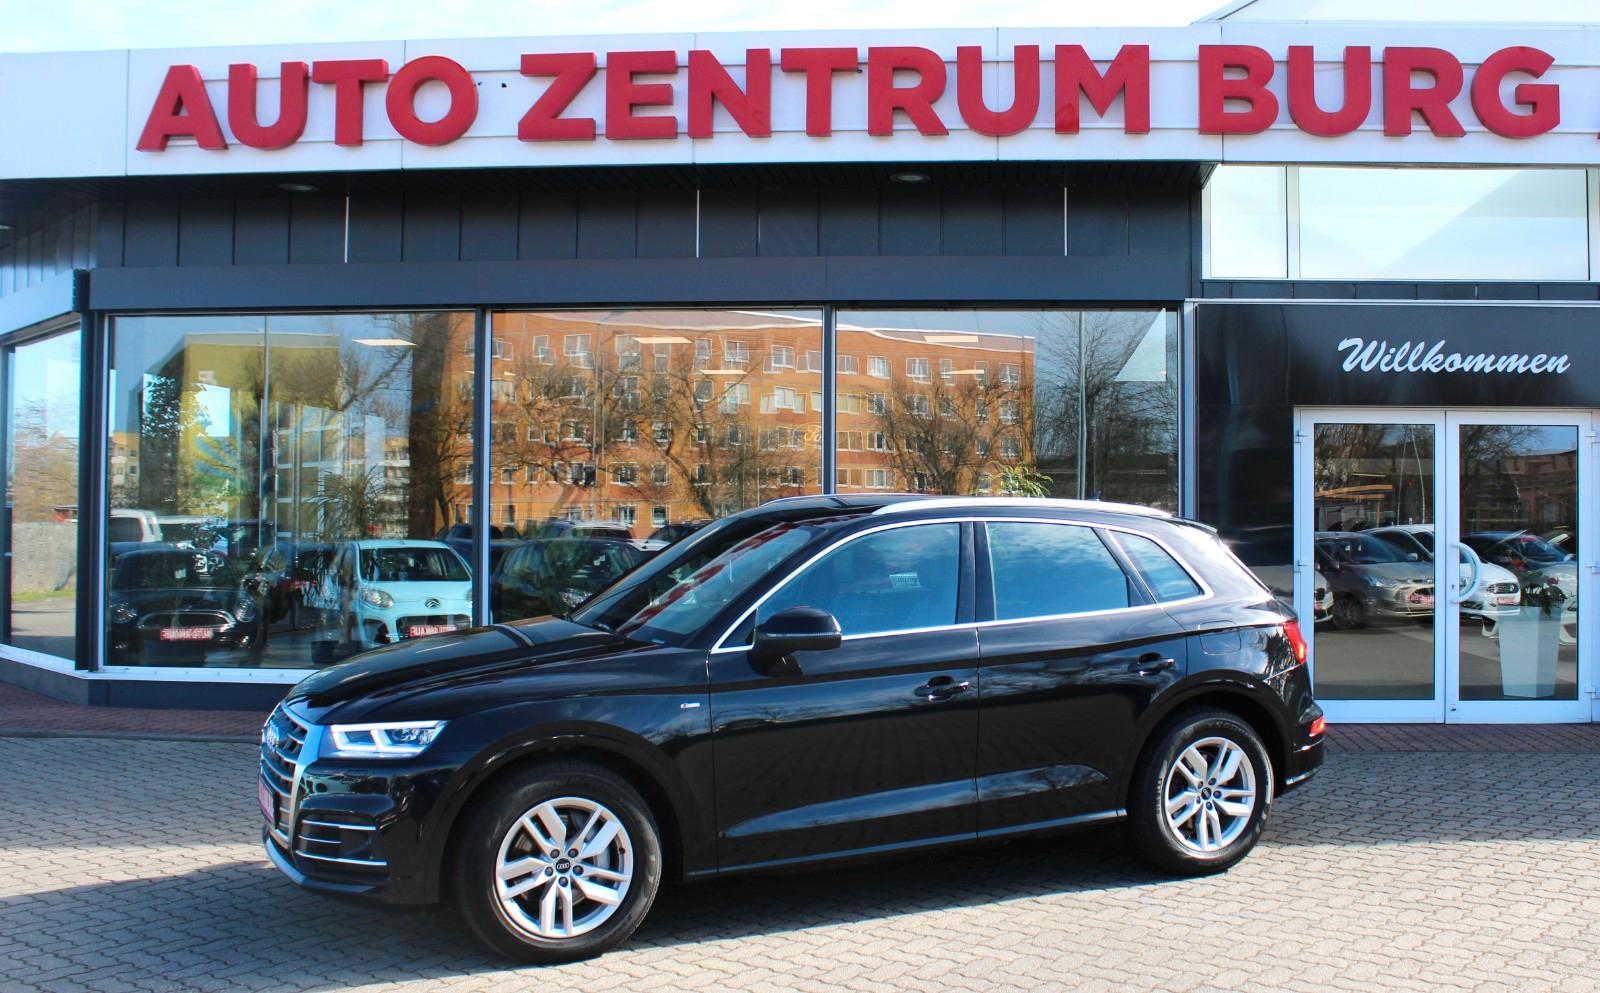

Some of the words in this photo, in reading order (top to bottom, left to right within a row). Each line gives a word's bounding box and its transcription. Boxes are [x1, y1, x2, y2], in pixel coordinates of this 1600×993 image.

[137, 55, 478, 151] AUTO
[517, 44, 1151, 141] ZENTRUM
[1198, 44, 1560, 138] BURG
[1337, 337, 1571, 374] Willkommen
